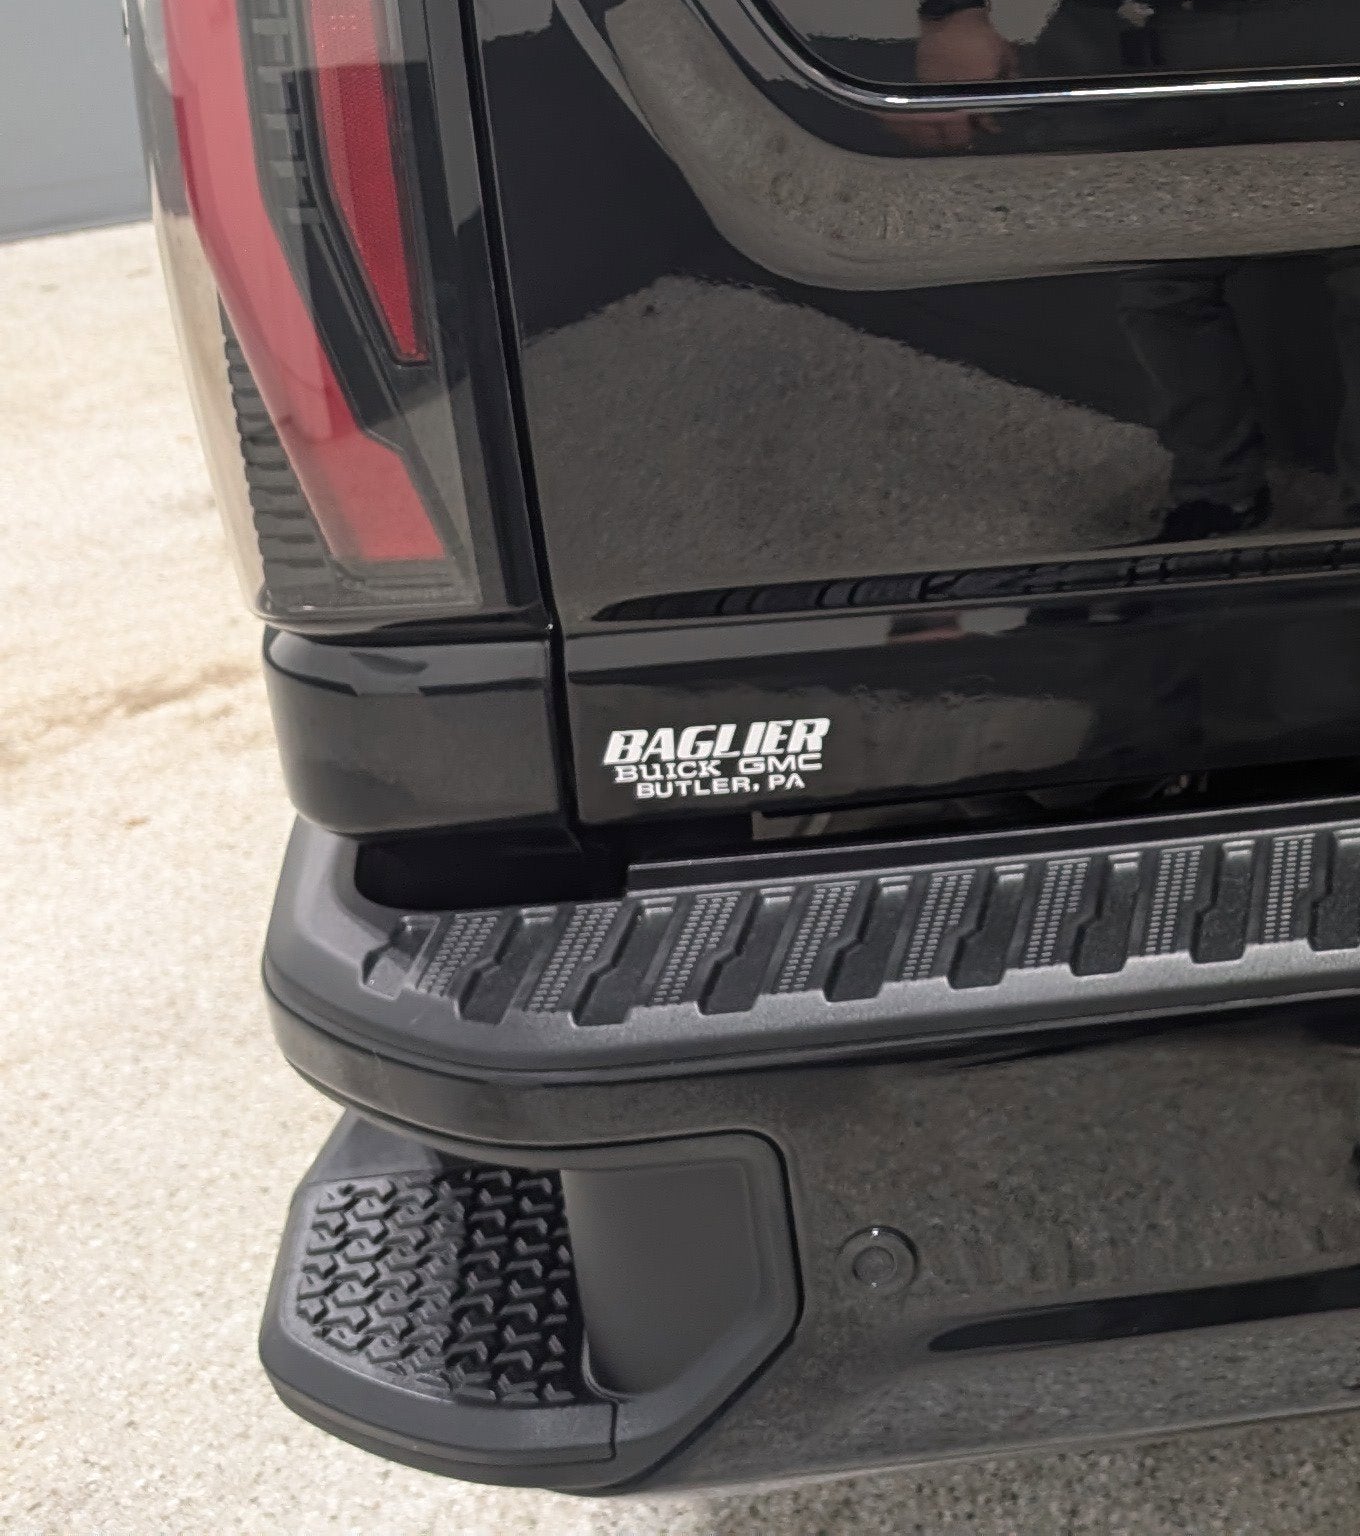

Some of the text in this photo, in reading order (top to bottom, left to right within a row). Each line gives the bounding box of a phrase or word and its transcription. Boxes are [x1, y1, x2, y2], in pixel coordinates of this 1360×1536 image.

[603, 717, 831, 767] BAGLIER
[738, 753, 823, 775] GMC
[637, 773, 806, 799] BUTLER, PA
